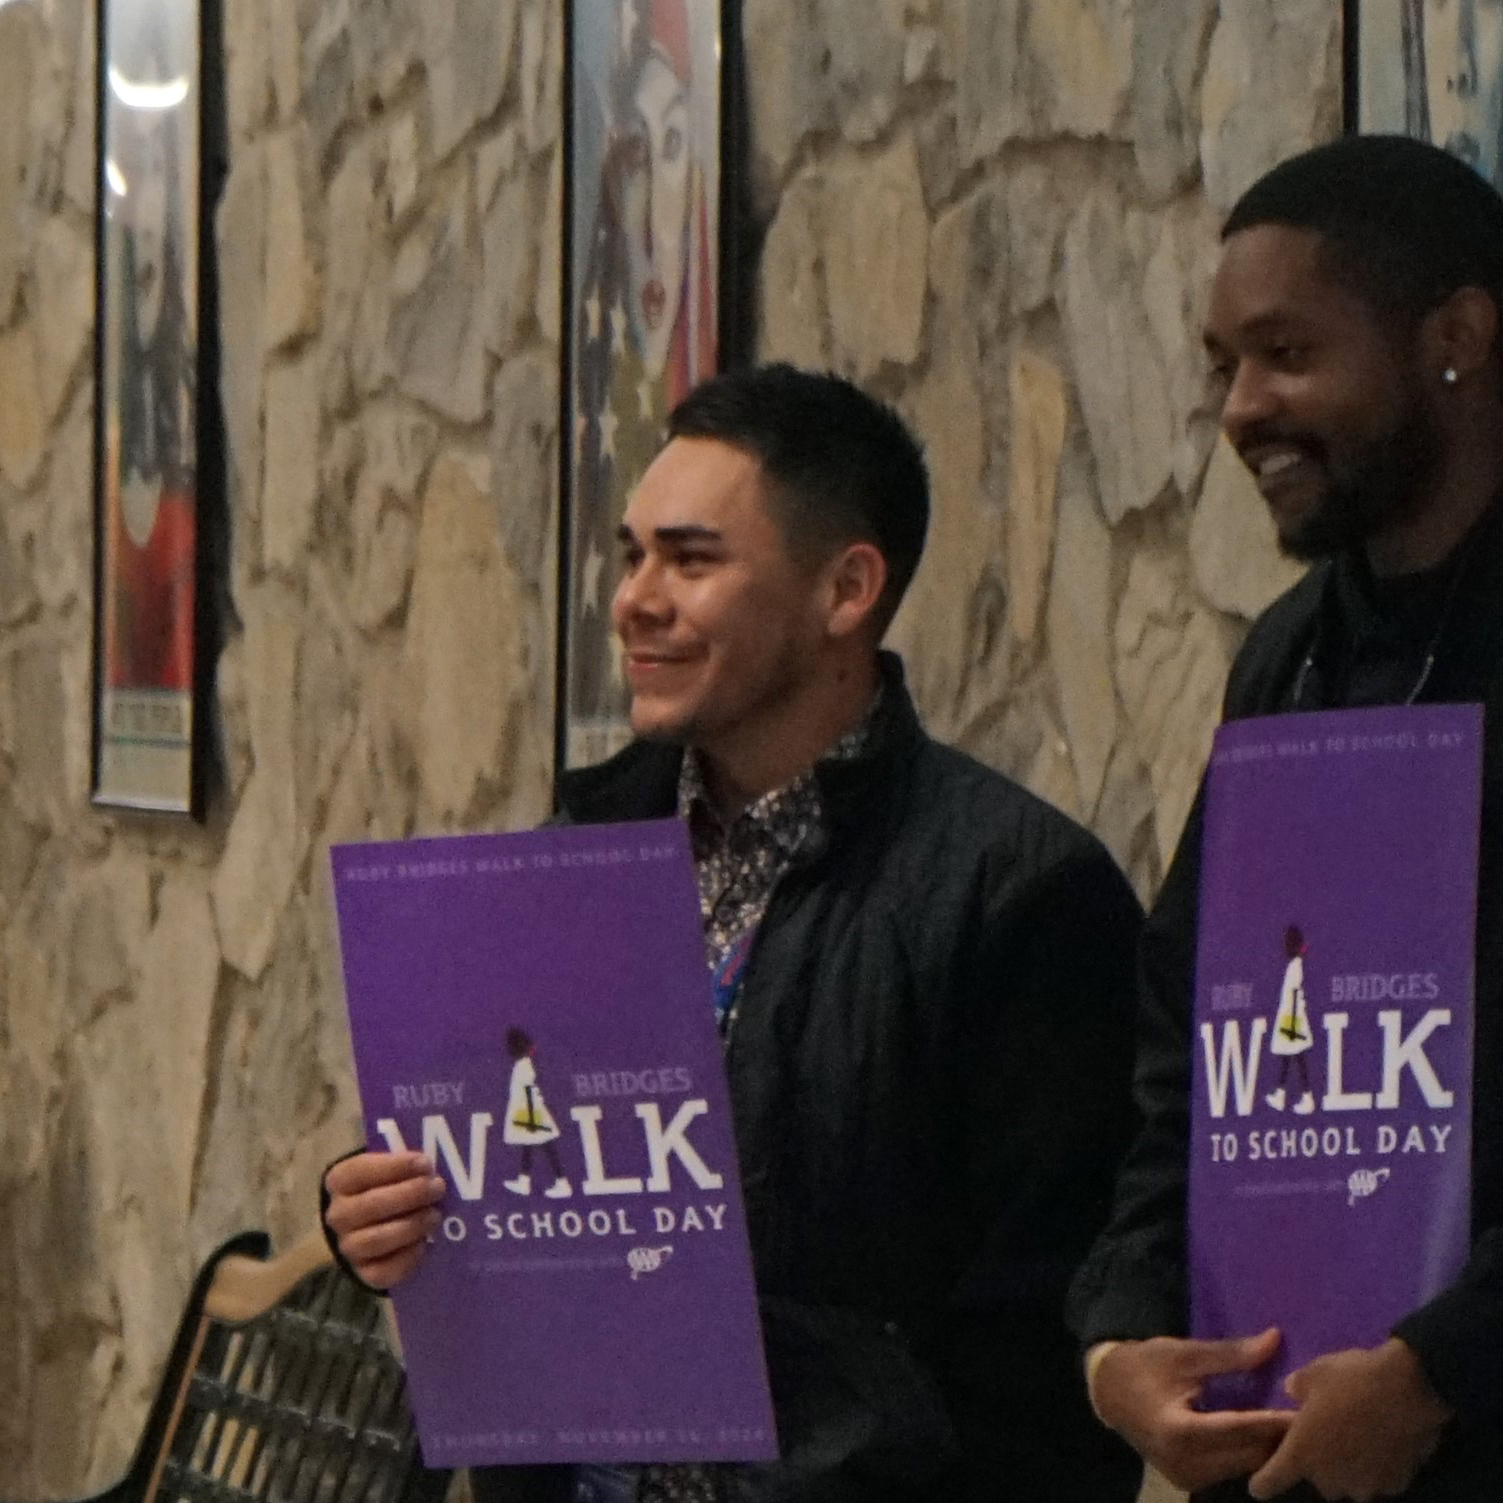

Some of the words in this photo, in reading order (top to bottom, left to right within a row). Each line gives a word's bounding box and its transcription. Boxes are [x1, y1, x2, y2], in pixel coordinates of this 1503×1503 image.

[1331, 972, 1441, 1003] BRIDGES
[1200, 957, 1455, 1118] WALK
[392, 1081, 464, 1109] RUBY
[573, 1066, 692, 1097] BRIDGES
[377, 1057, 724, 1201] WALK
[1210, 1132, 1239, 1162] TO
[1248, 1126, 1361, 1161] SCHOOL
[1377, 1124, 1453, 1154] DAY
[483, 1209, 637, 1240] SCHOOL
[652, 1203, 727, 1233] DAY
